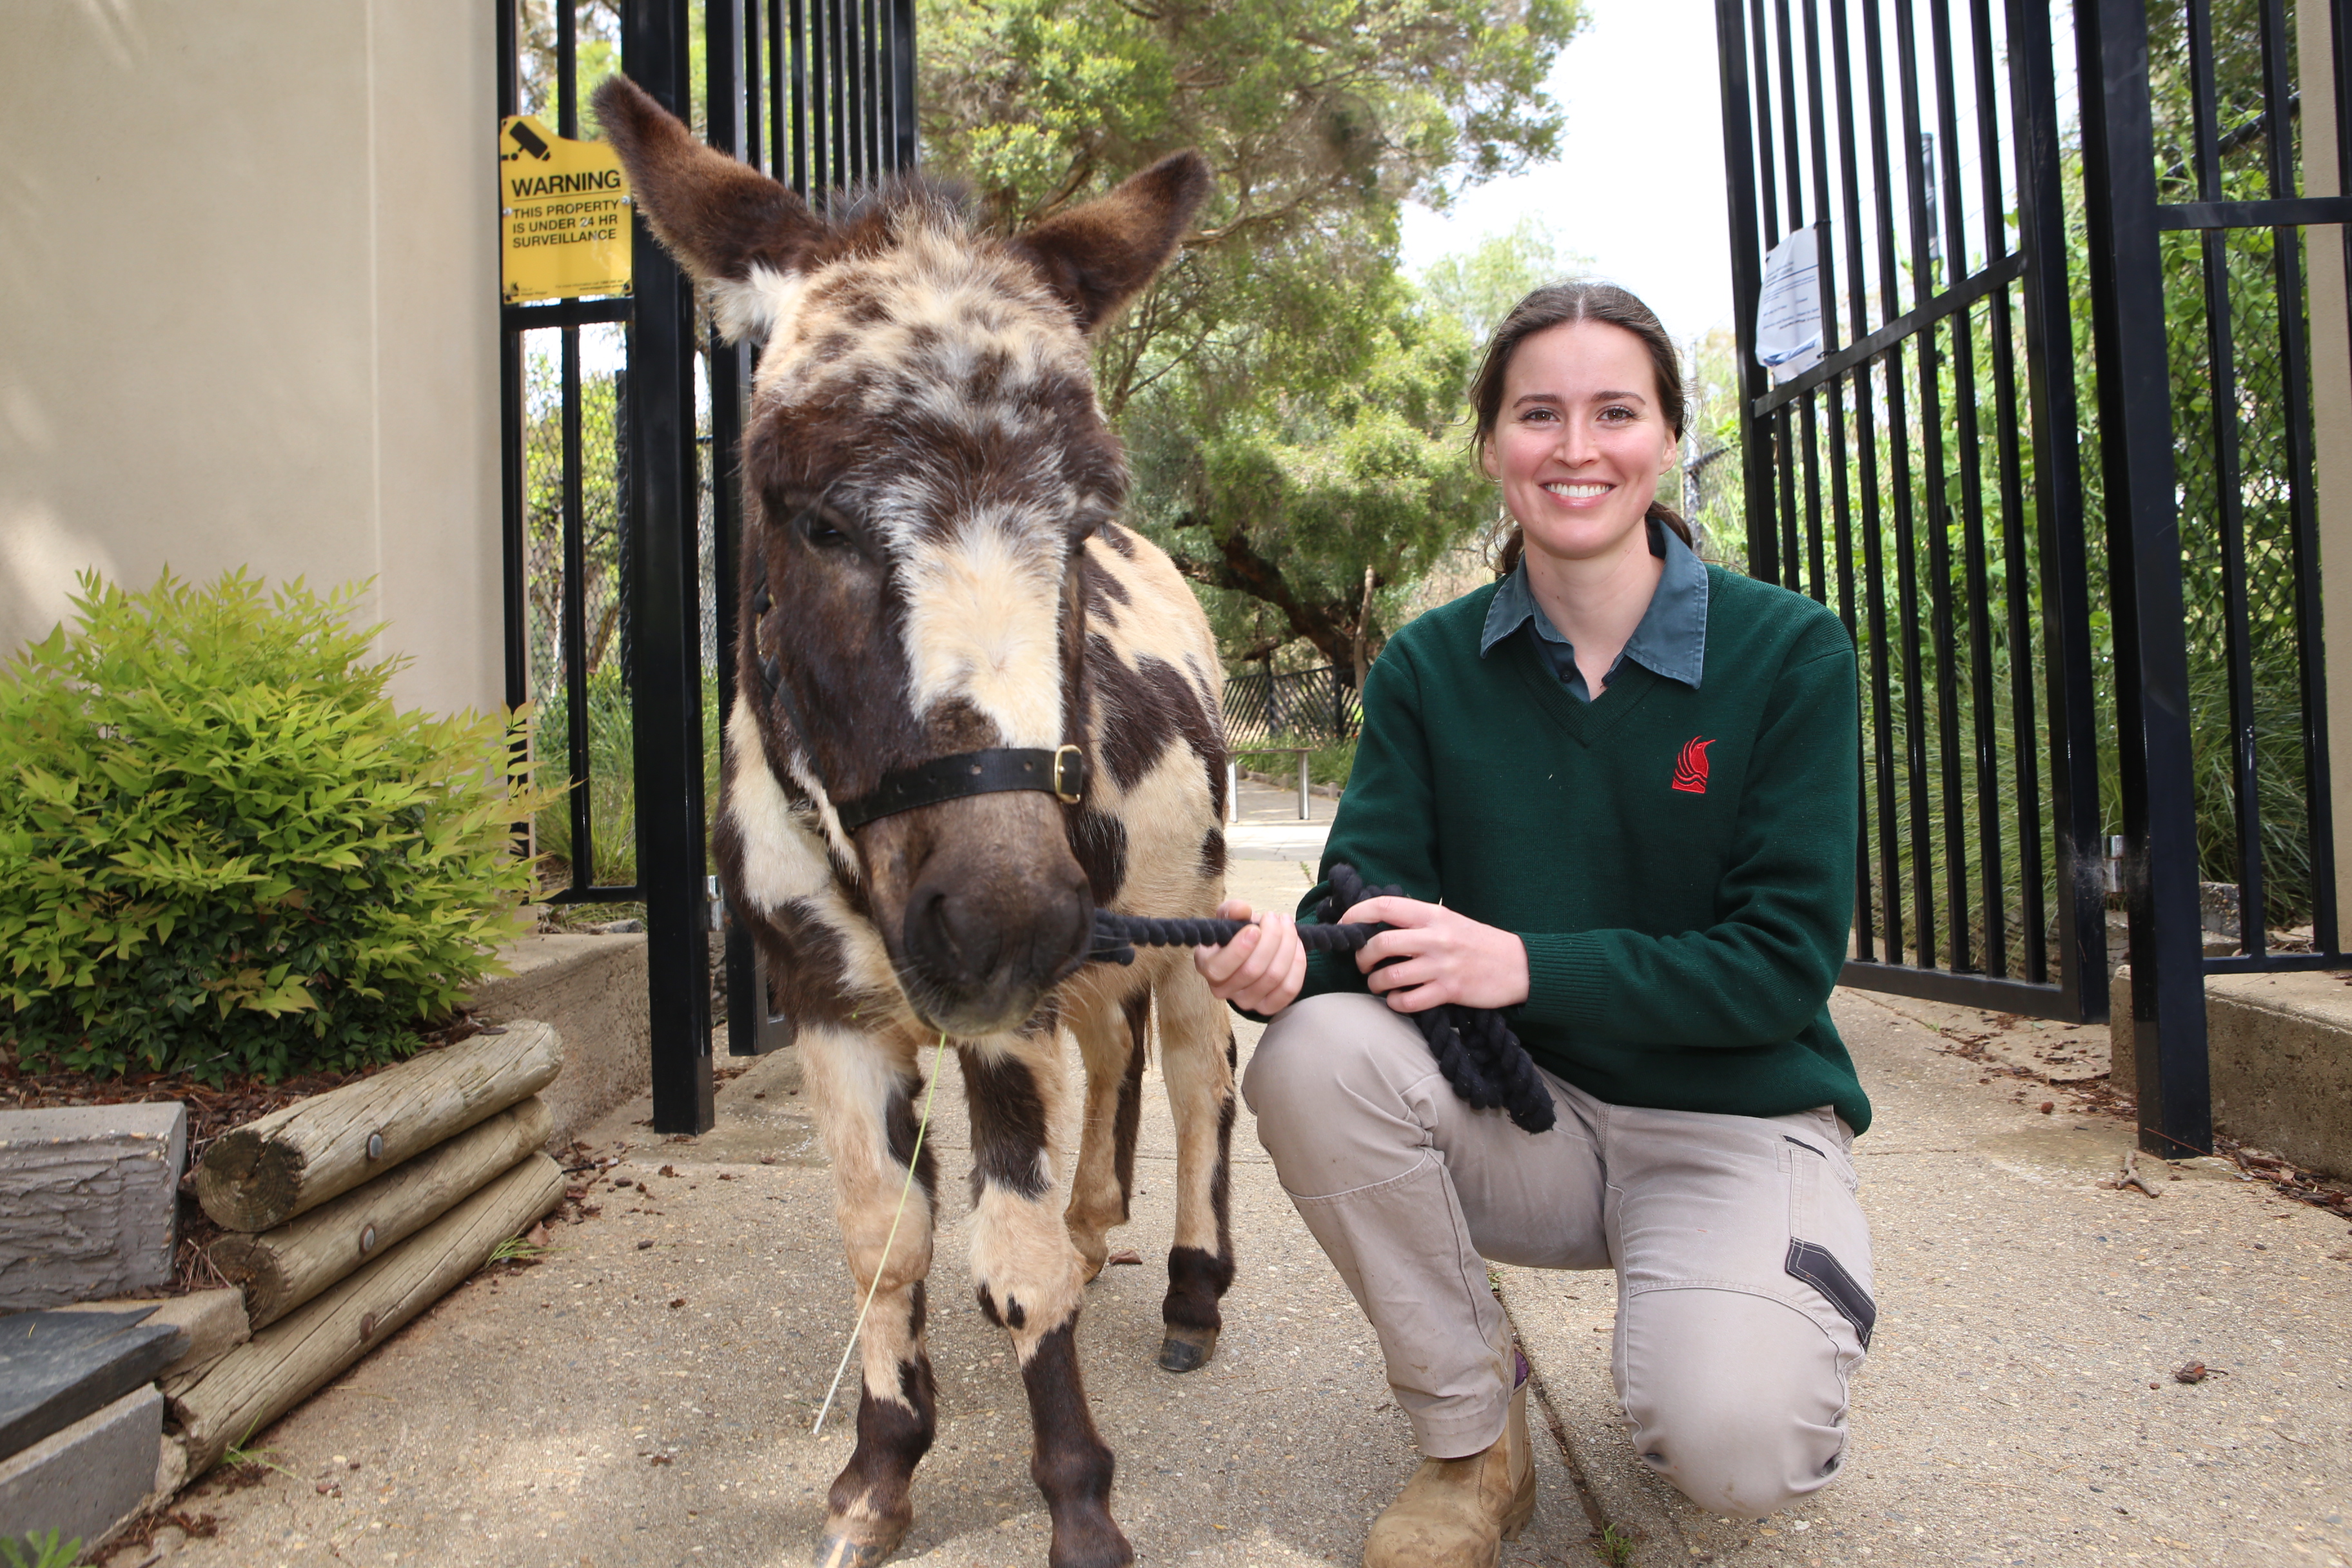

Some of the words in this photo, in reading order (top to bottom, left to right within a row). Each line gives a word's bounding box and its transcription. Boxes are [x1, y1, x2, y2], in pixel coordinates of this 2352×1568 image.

[511, 170, 621, 197] WARNING
[514, 206, 542, 219] THIS
[547, 200, 619, 215] PROPERTY
[513, 223, 525, 234] IS
[529, 218, 576, 232] UNDER
[580, 216, 594, 228] 24
[599, 214, 618, 226] HR
[513, 228, 617, 248] SURVEILLANCE
